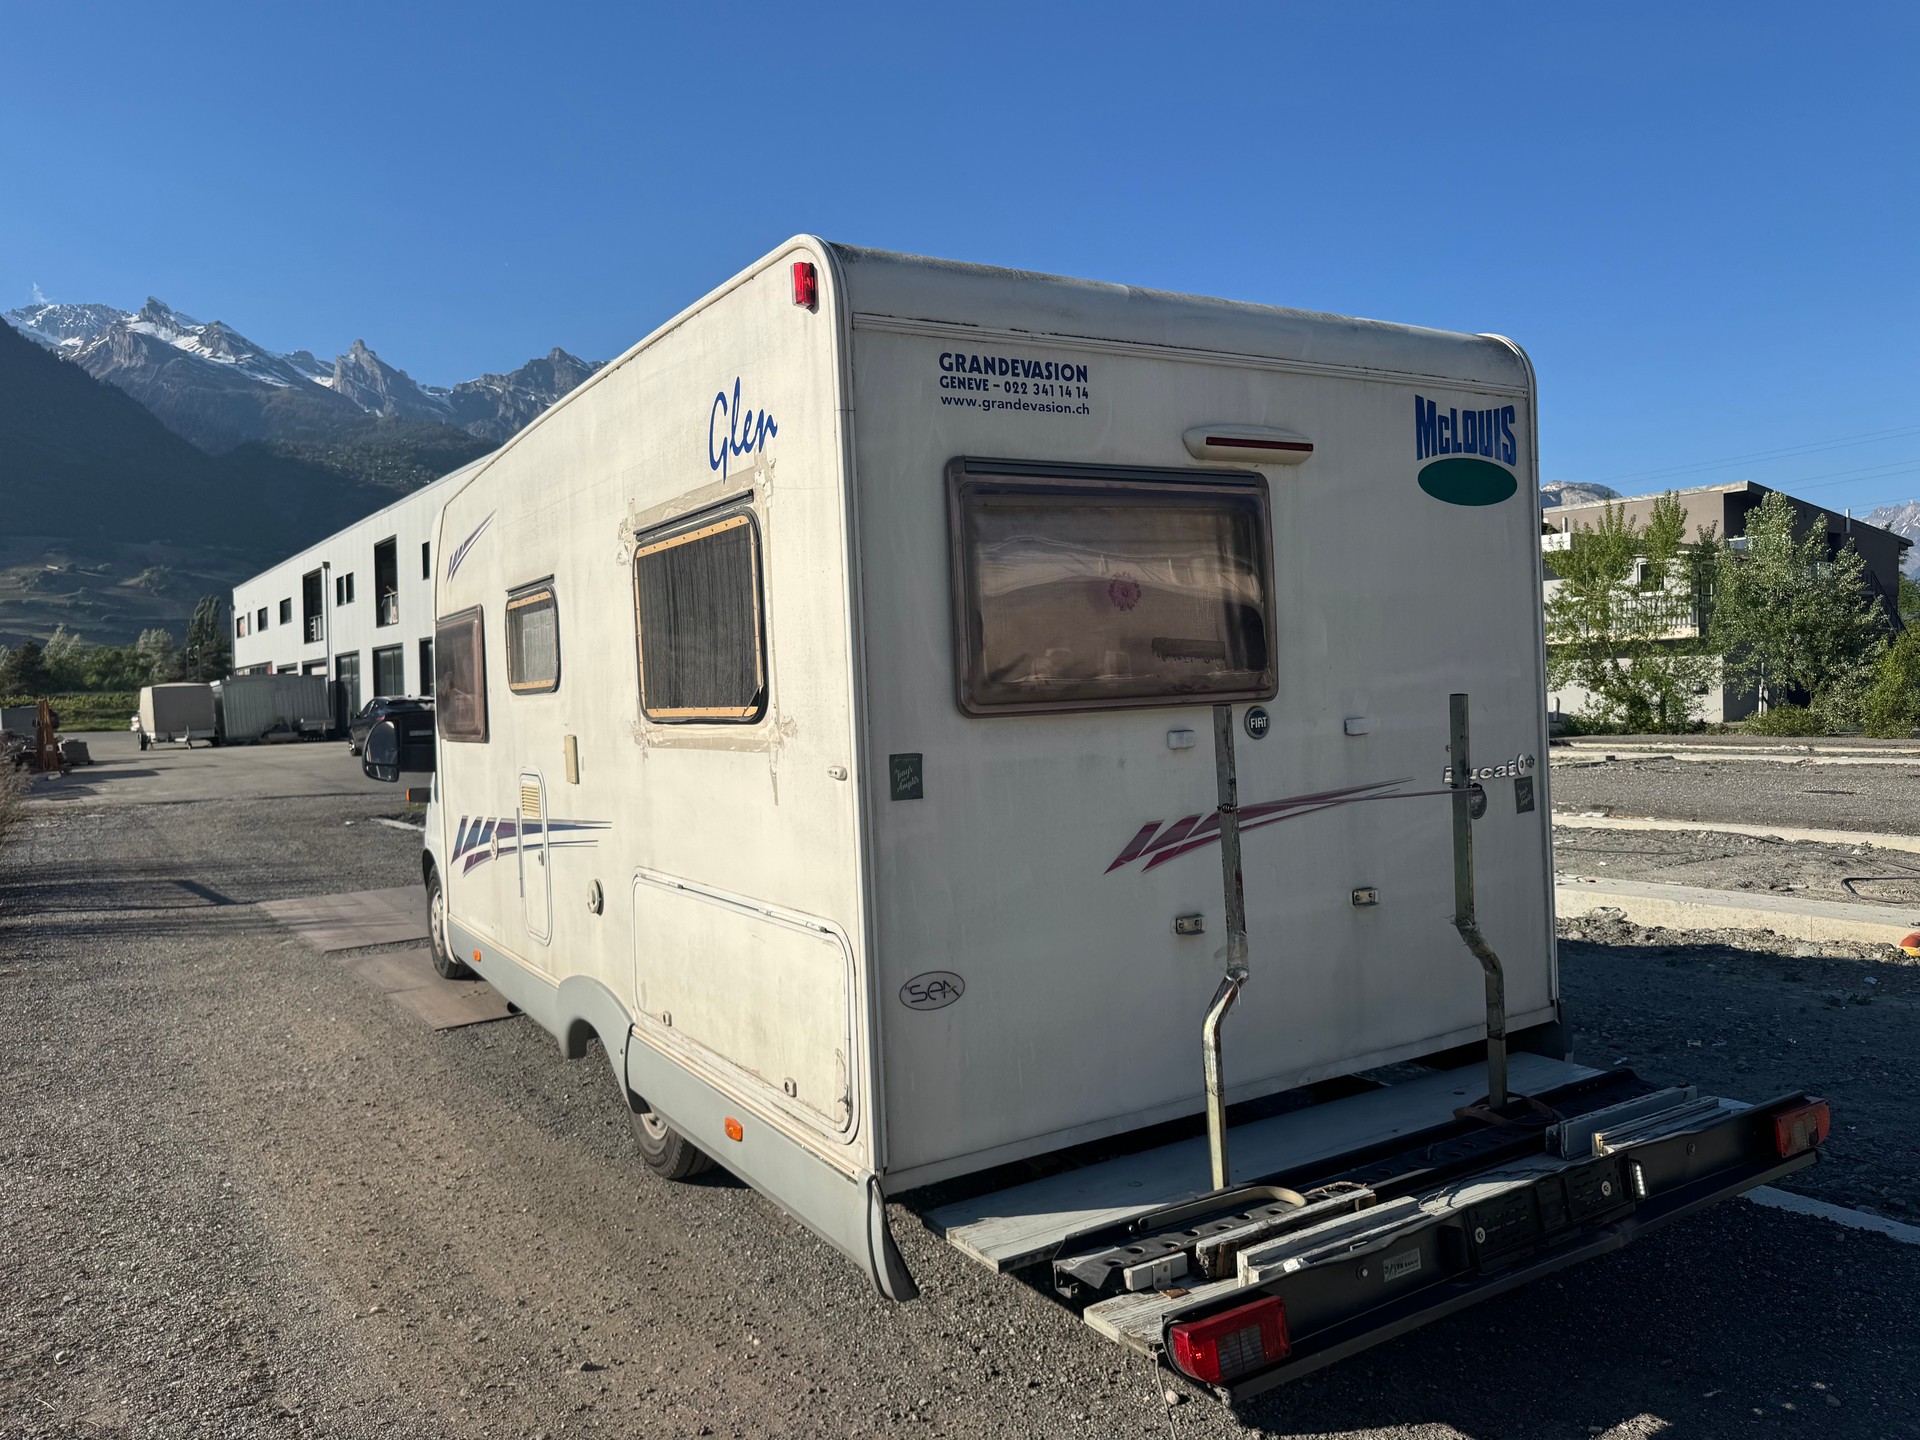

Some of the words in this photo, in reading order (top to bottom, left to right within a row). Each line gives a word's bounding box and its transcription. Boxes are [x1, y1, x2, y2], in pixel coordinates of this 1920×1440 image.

[939, 352, 1088, 383] GRANDEVASION
[939, 375, 990, 392] GENEVE
[1004, 381, 1028, 395] 022
[1033, 383, 1055, 397] 341
[1059, 385, 1073, 398] 14
[1076, 386, 1089, 399] 14
[940, 396, 1090, 415] www.grandevasion.ch
[709, 376, 778, 485] Glen
[1250, 716, 1267, 729] FIAT
